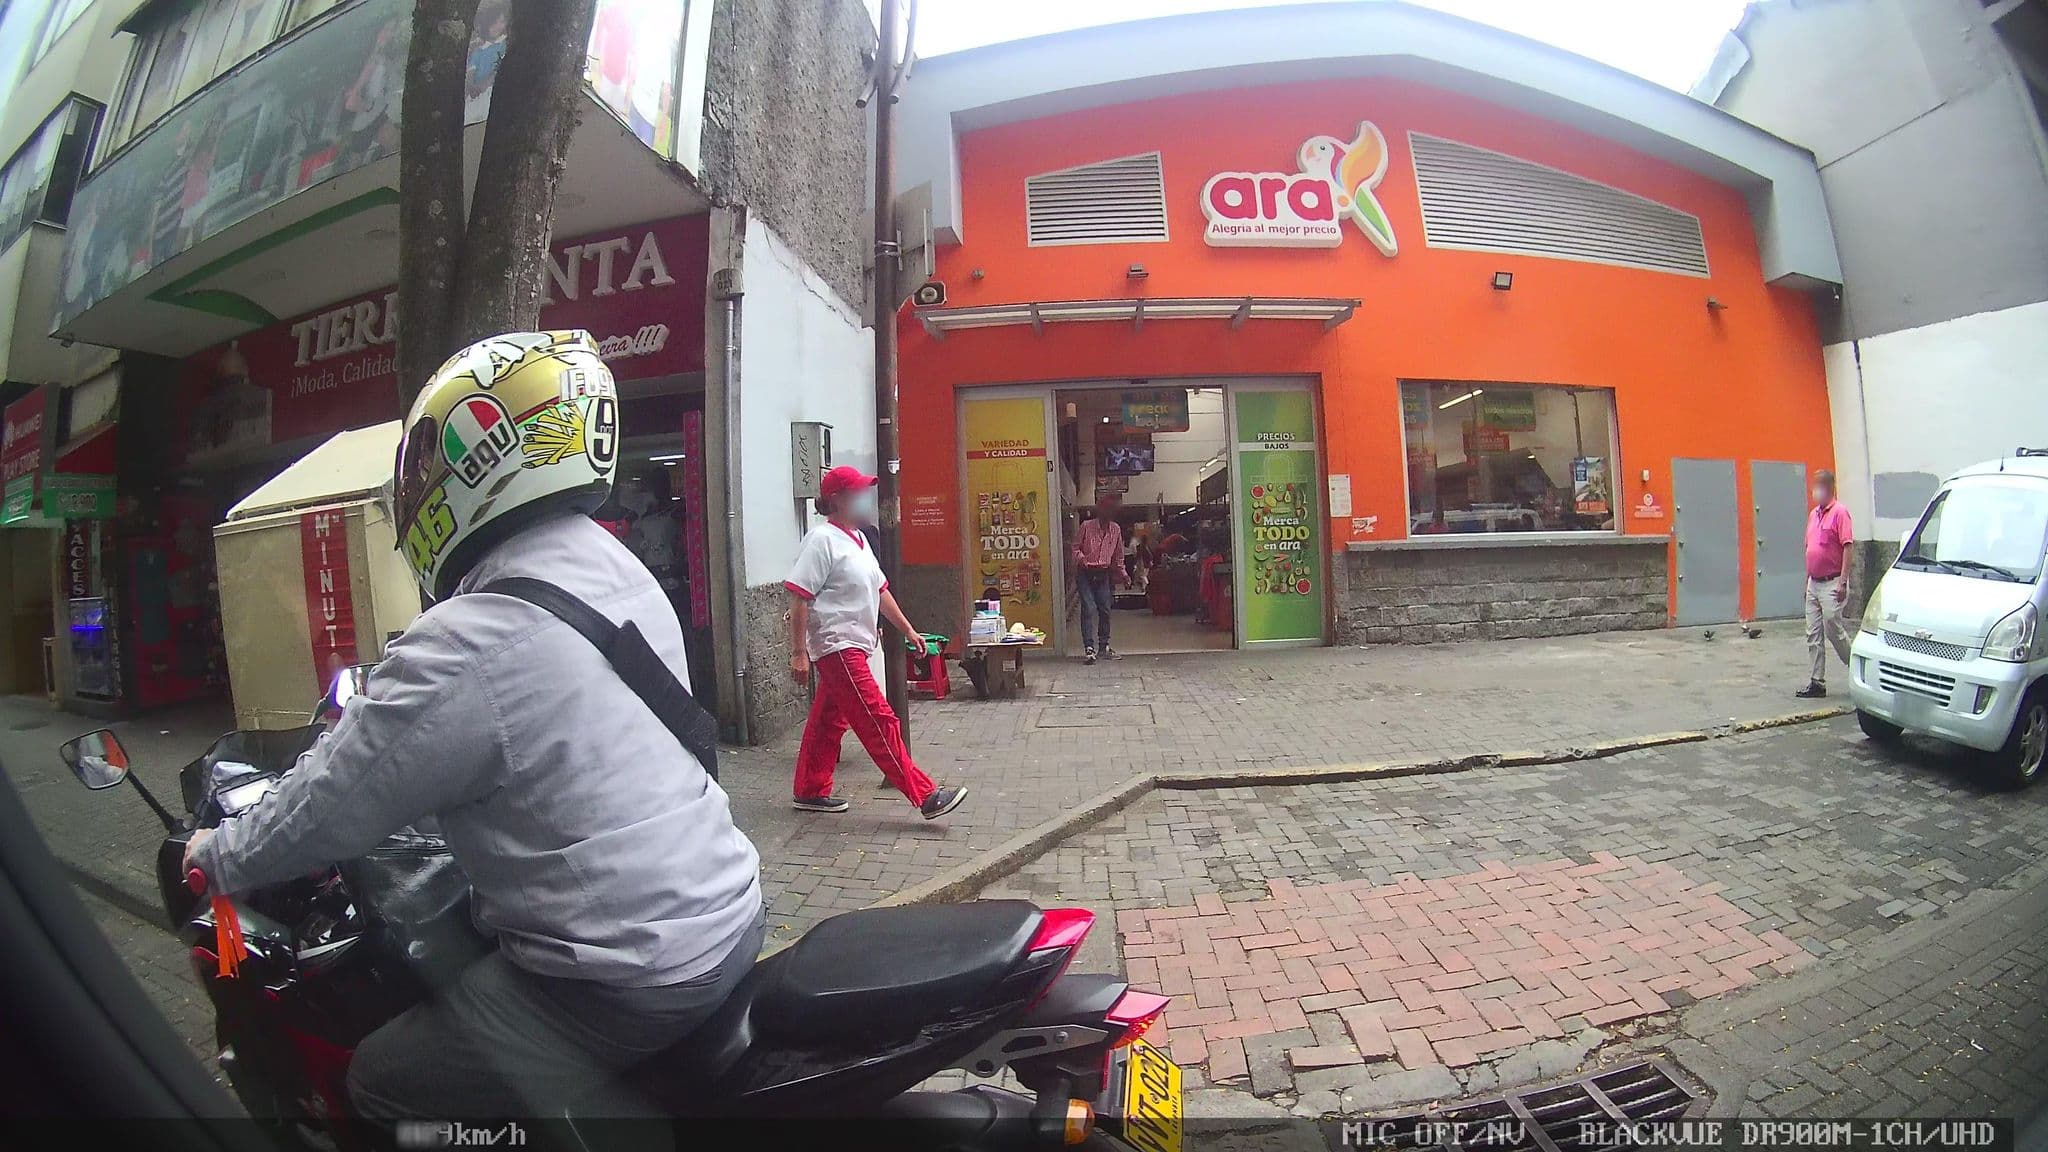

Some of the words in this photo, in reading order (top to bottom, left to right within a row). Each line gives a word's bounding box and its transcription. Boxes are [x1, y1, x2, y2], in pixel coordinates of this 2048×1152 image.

[1209, 177, 1334, 221] ara
[1255, 224, 1264, 233] al
[1269, 225, 1300, 236] mejor
[1303, 226, 1337, 236] precio
[1257, 432, 1296, 441] PRECIOS
[981, 440, 1029, 448] VARIEDAD
[1264, 442, 1289, 450] BAJOS
[985, 450, 991, 458] Y
[992, 449, 1027, 457] CALIDAD
[1263, 516, 1300, 526] Merca
[990, 526, 1028, 535] Merca
[1253, 526, 1310, 542] TODO
[980, 535, 1040, 551] TODO
[1278, 541, 1301, 550] ara
[991, 552, 1005, 560] en
[1007, 550, 1030, 560] ara
